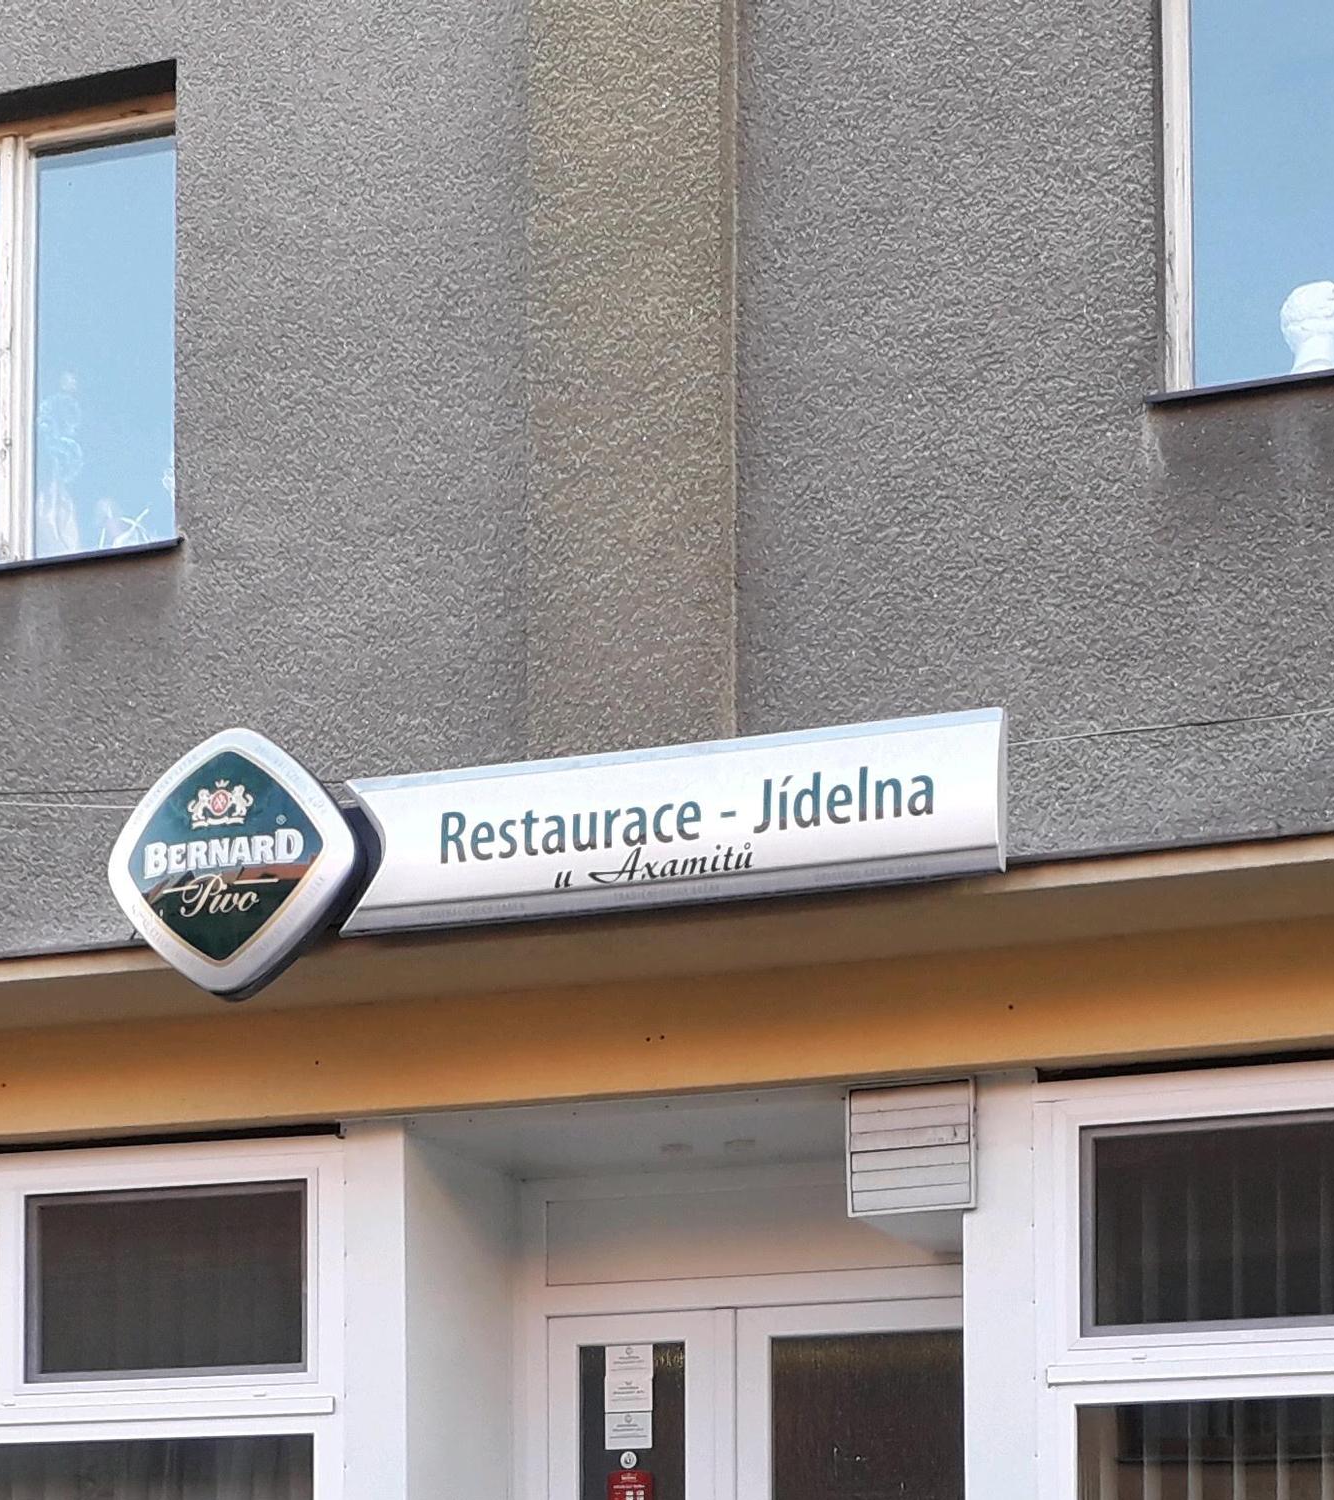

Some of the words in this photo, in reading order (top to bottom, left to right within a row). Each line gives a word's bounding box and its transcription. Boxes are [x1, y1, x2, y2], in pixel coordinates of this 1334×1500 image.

[440, 800, 702, 865] Restaurace
[720, 810, 737, 819] -
[753, 766, 934, 834] Jídelna
[144, 828, 305, 880] BERNARD
[553, 870, 573, 889] u
[588, 842, 754, 885] Axamitů
[179, 873, 260, 918] Pivo
